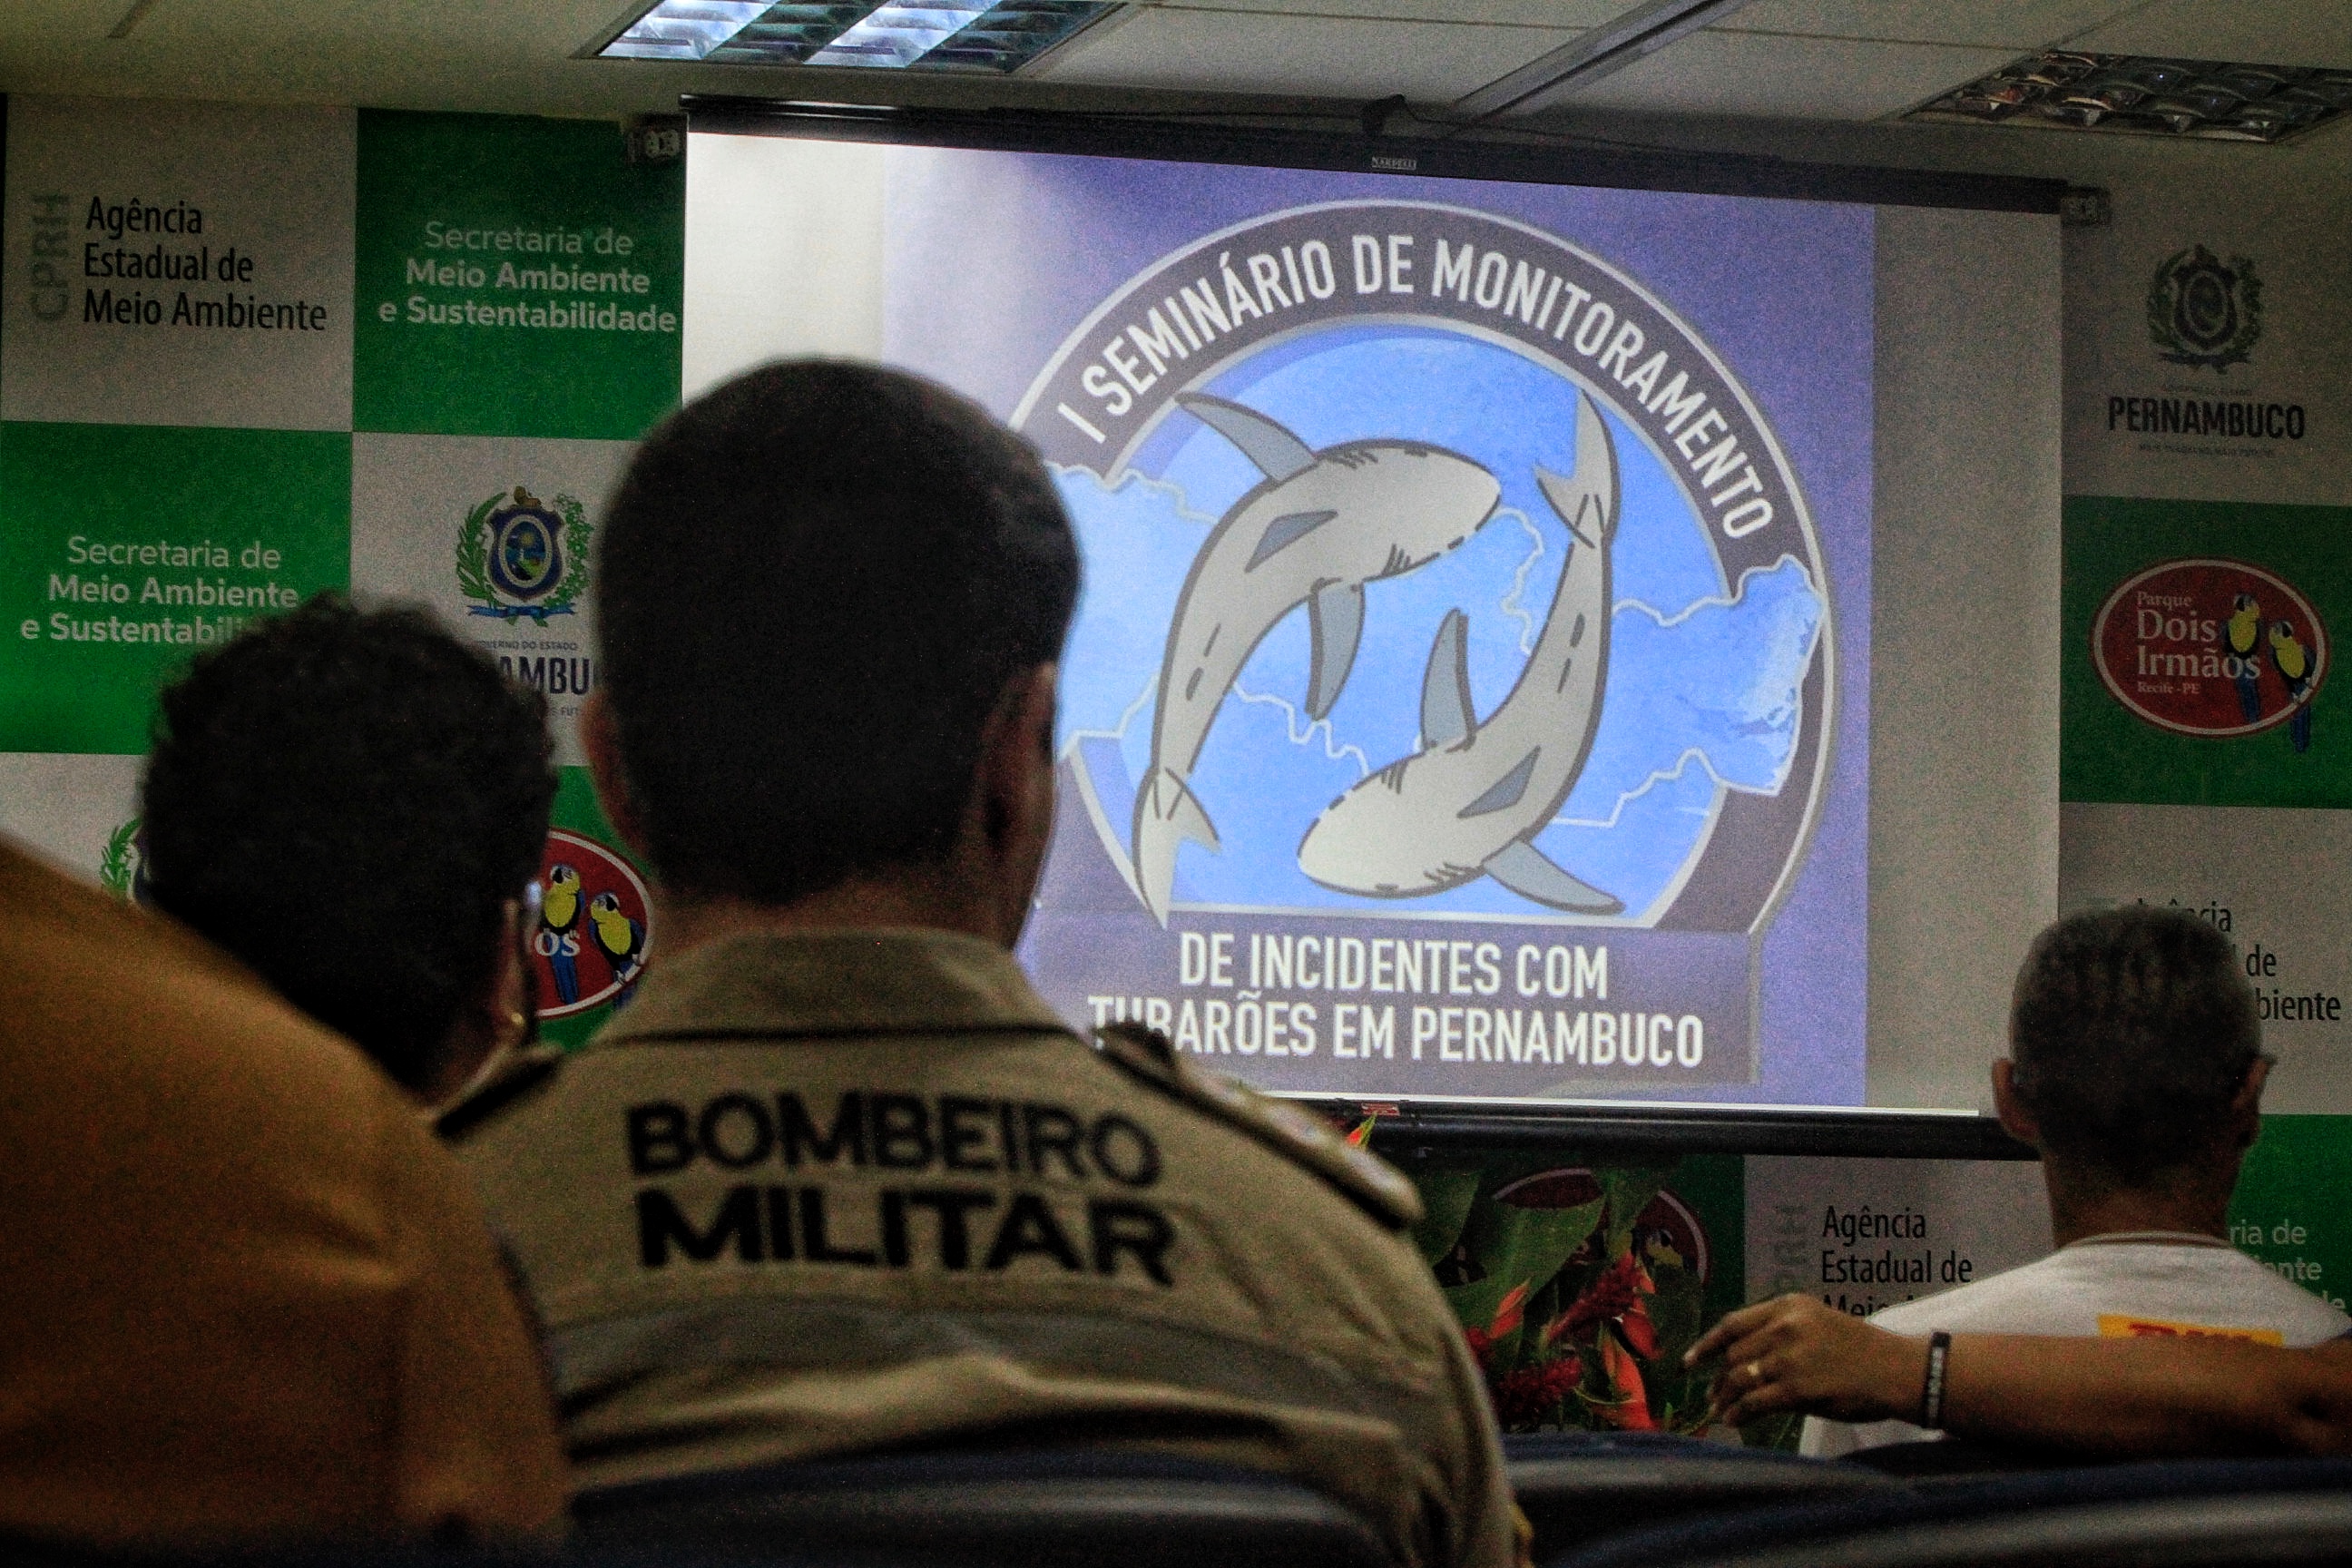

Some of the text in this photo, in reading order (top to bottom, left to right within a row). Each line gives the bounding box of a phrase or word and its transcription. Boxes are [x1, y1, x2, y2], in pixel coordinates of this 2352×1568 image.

[86, 197, 202, 240] Agência
[425, 220, 632, 256] Secretaria de
[31, 193, 70, 322] CPRH
[84, 243, 253, 284] Estadual de
[407, 259, 651, 295] Meio Ambiente
[83, 289, 328, 332] Meio Ambiente
[379, 296, 677, 334] e Sustentabilidade
[1058, 234, 1774, 543] I SEMINÁRIO DE MONITORAMENTO
[2108, 396, 2306, 440] PERNAMBUCO
[67, 536, 281, 569] Secretaria de
[48, 573, 299, 609] Meio Ambiente
[2137, 591, 2193, 612] Parque
[21, 618, 40, 640] e
[2137, 609, 2218, 642] Dois
[2137, 647, 2262, 680] Irmãos
[1180, 932, 1609, 1000] DE INCIDENTES COM
[2245, 944, 2277, 977] de
[2255, 987, 2341, 1021] biente
[1334, 1004, 1396, 1059] EM
[1411, 1006, 1704, 1068] PERNAMBUCO
[627, 1091, 1162, 1186] BOMBEIRO
[637, 1183, 1178, 1289] MILITAR
[1822, 1204, 1926, 1247] Agência
[2271, 1218, 2308, 1246] de
[1821, 1249, 1973, 1284] Estadual de
